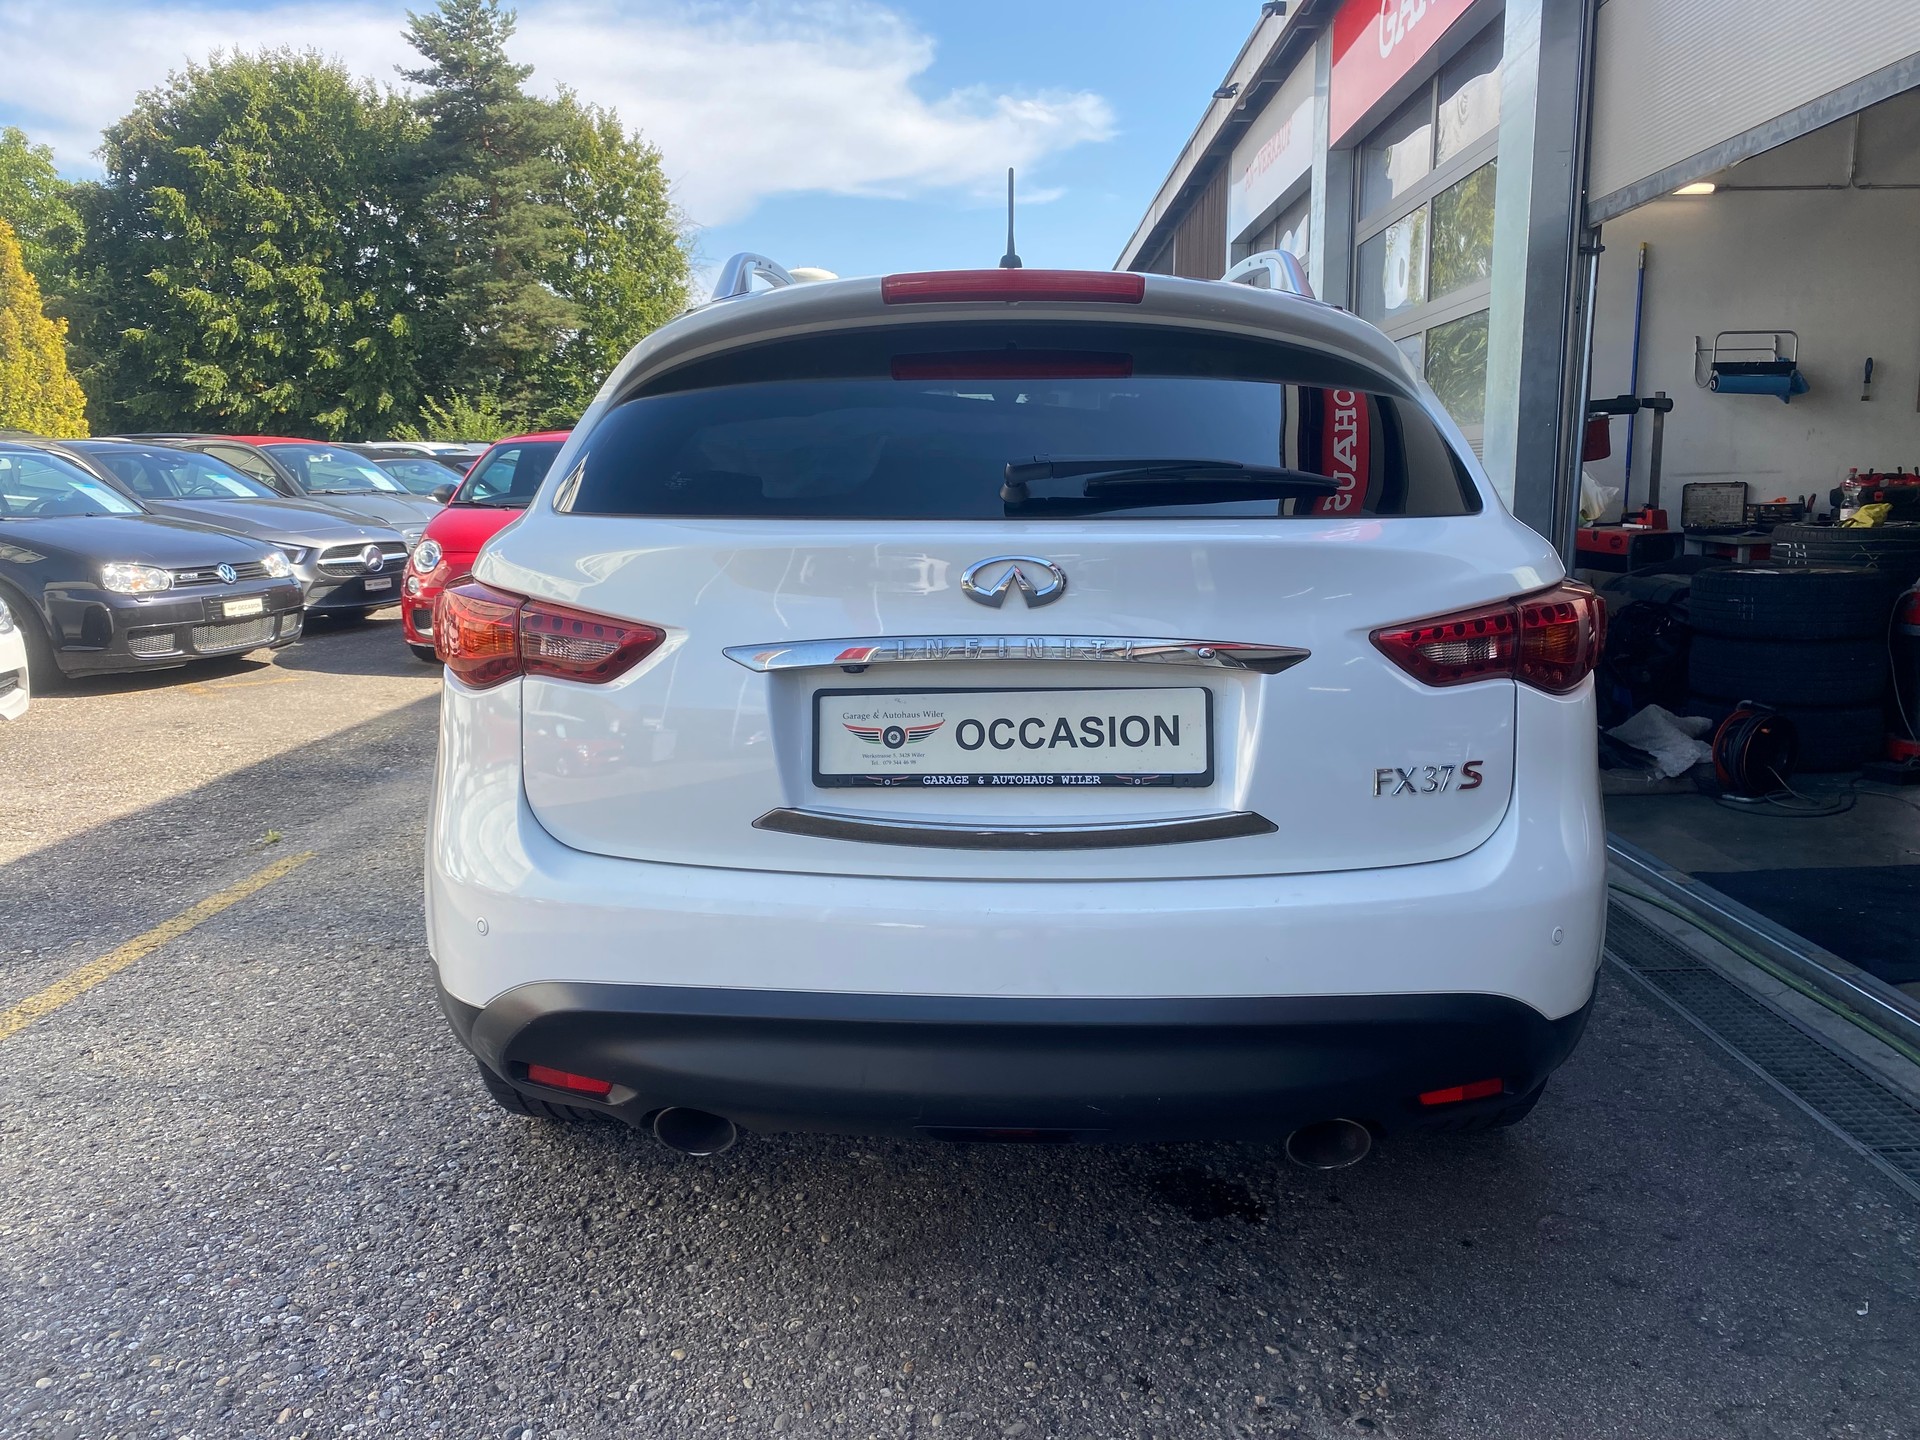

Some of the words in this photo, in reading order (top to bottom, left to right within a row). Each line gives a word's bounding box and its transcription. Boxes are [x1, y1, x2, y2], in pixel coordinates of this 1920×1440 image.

[897, 638, 1133, 660] INFINITI
[842, 712, 871, 721] Garage
[873, 711, 879, 719] &
[882, 711, 920, 719] Autohaus
[923, 710, 944, 718] Wiler
[955, 715, 1180, 750] OCCASION
[922, 775, 969, 785] GARAGE
[977, 776, 984, 785] &
[991, 775, 1054, 785] AUTOHAUS
[1061, 775, 1101, 785] WILER
